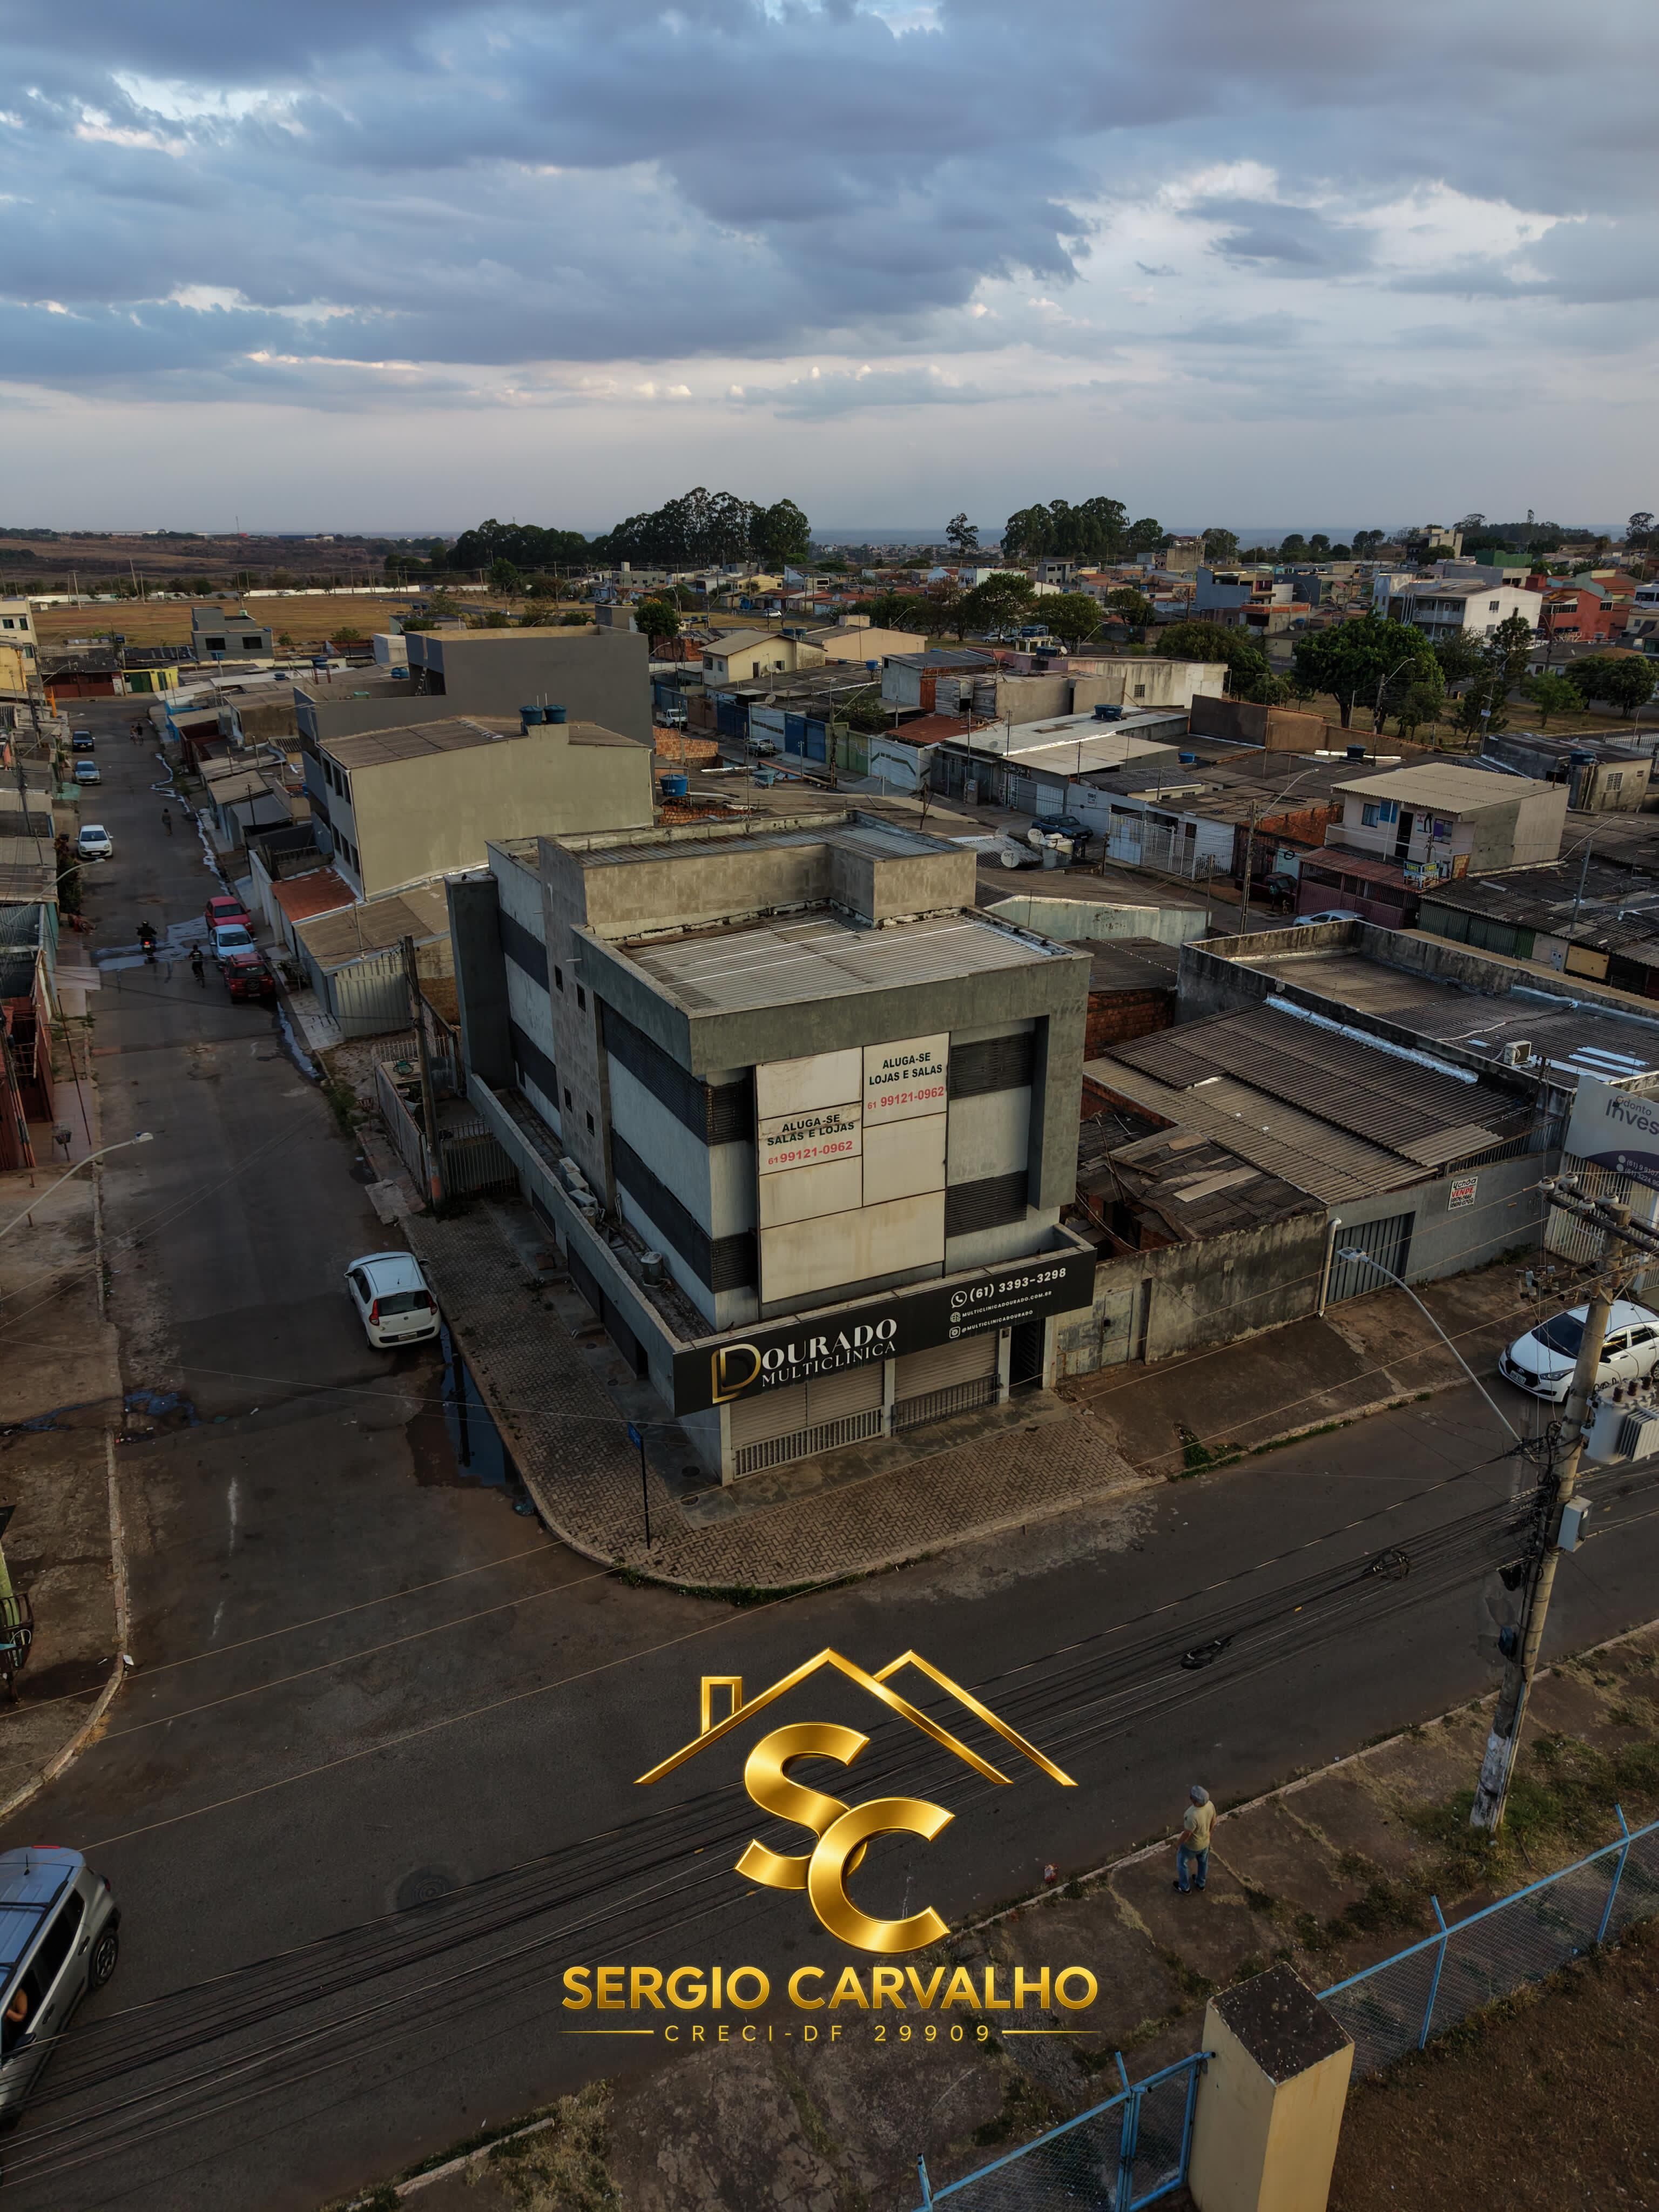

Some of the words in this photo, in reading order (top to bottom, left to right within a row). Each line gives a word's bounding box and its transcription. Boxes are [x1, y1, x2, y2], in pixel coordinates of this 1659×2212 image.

[882, 1053, 930, 1069] ALUGA-SE
[869, 1072, 900, 1085] LOJAS
[903, 1070, 909, 1079] E
[912, 1064, 942, 1078] SALAS
[881, 1086, 945, 1107] 99121-0962
[1616, 1095, 1651, 1116] Odonto
[767, 1132, 804, 1146] SALAS
[808, 1129, 815, 1138] E
[819, 1122, 854, 1136] LOJAS
[768, 1157, 778, 1165] 61
[780, 1141, 853, 1163] 99121-0962
[1452, 1186, 1474, 1197] VENDE
[970, 1284, 994, 1302] (61)
[999, 1268, 1066, 1292] 3393-3298
[962, 1291, 1052, 1318] MULTICLINICADOURADO.COM.BR
[961, 1310, 1033, 1333] @MULTICLINICADOURADO
[762, 1341, 895, 1387] MULTICLÍNICA
